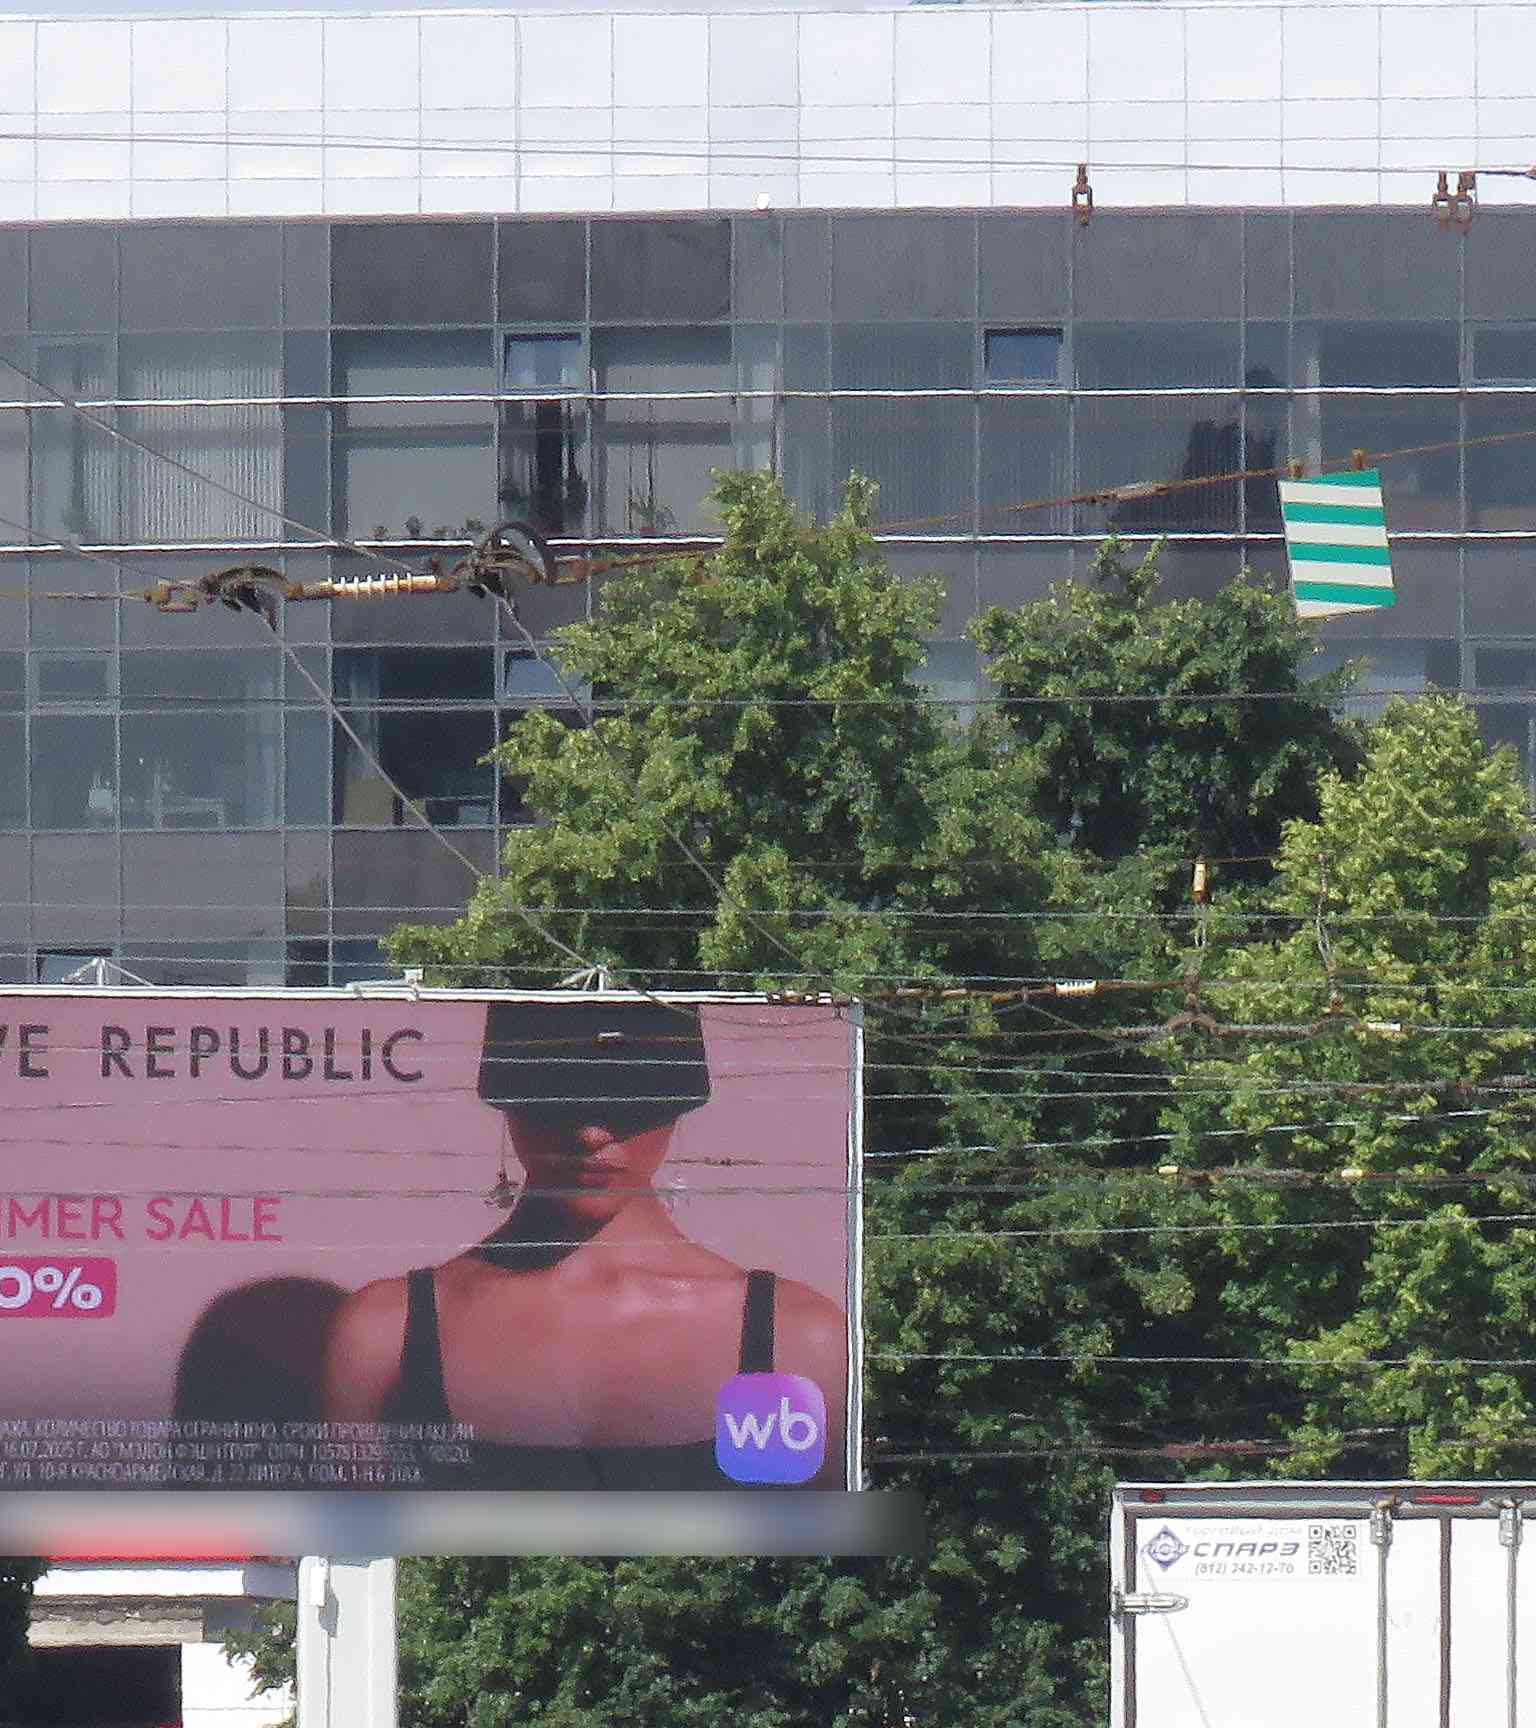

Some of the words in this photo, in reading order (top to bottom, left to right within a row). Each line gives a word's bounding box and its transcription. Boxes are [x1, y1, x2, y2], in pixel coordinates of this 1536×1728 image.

[100, 1025, 426, 1082] REPUBLIC
[145, 1196, 284, 1243] SALE
[723, 1396, 818, 1451] wb
[1193, 1541, 1300, 1558] СПАРЭ
